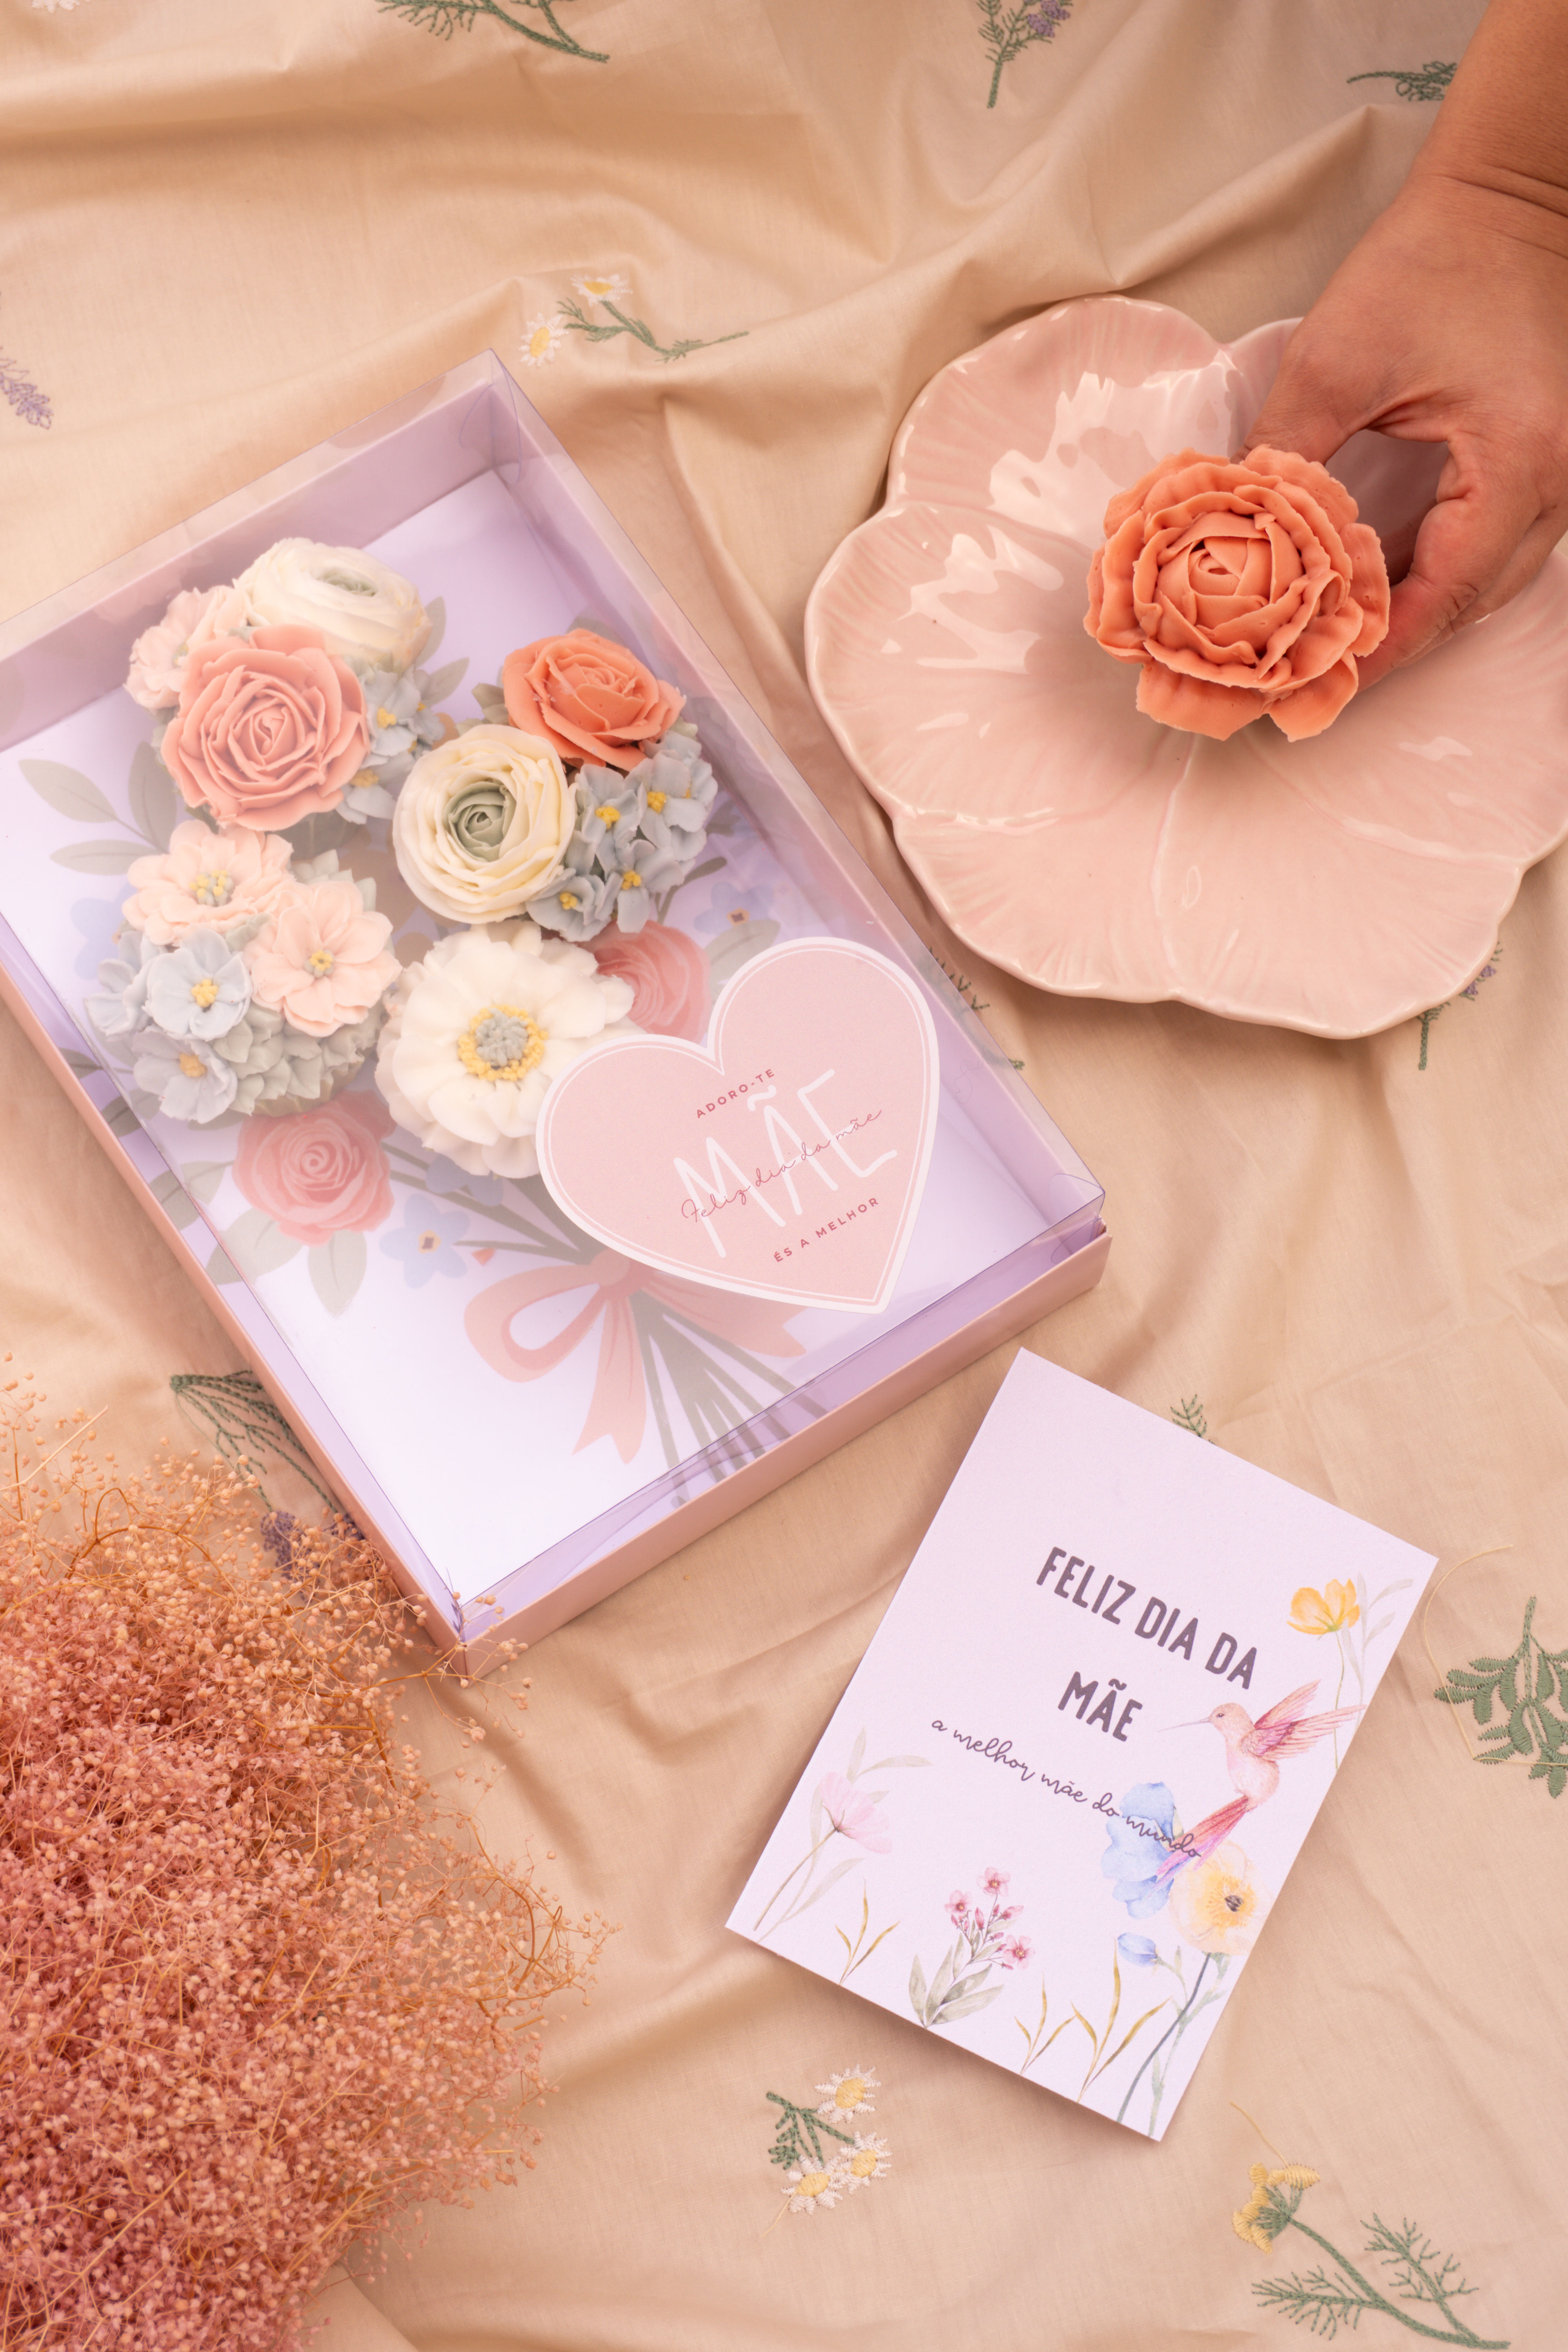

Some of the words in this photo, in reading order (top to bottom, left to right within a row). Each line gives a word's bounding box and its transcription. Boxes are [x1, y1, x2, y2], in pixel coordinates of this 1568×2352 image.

[696, 1069, 775, 1118] ADORO-TE
[673, 1069, 897, 1257] MÃE
[755, 1160, 796, 1187] dia
[801, 1140, 831, 1160] da
[835, 1109, 882, 1140] mãe
[773, 1247, 793, 1262] ÉS
[800, 1238, 809, 1248] A
[815, 1198, 878, 1238] MELHOR
[1036, 1546, 1136, 1625] FELIZ
[1134, 1596, 1199, 1661] DIA
[1204, 1632, 1258, 1690] DA
[1057, 1671, 1143, 1742] MÃE
[931, 1719, 947, 1731] a
[953, 1730, 1035, 1781] melhor
[1041, 1773, 1088, 1803] mãe
[1092, 1793, 1120, 1818] do
[1126, 1815, 1201, 1858] mundo
